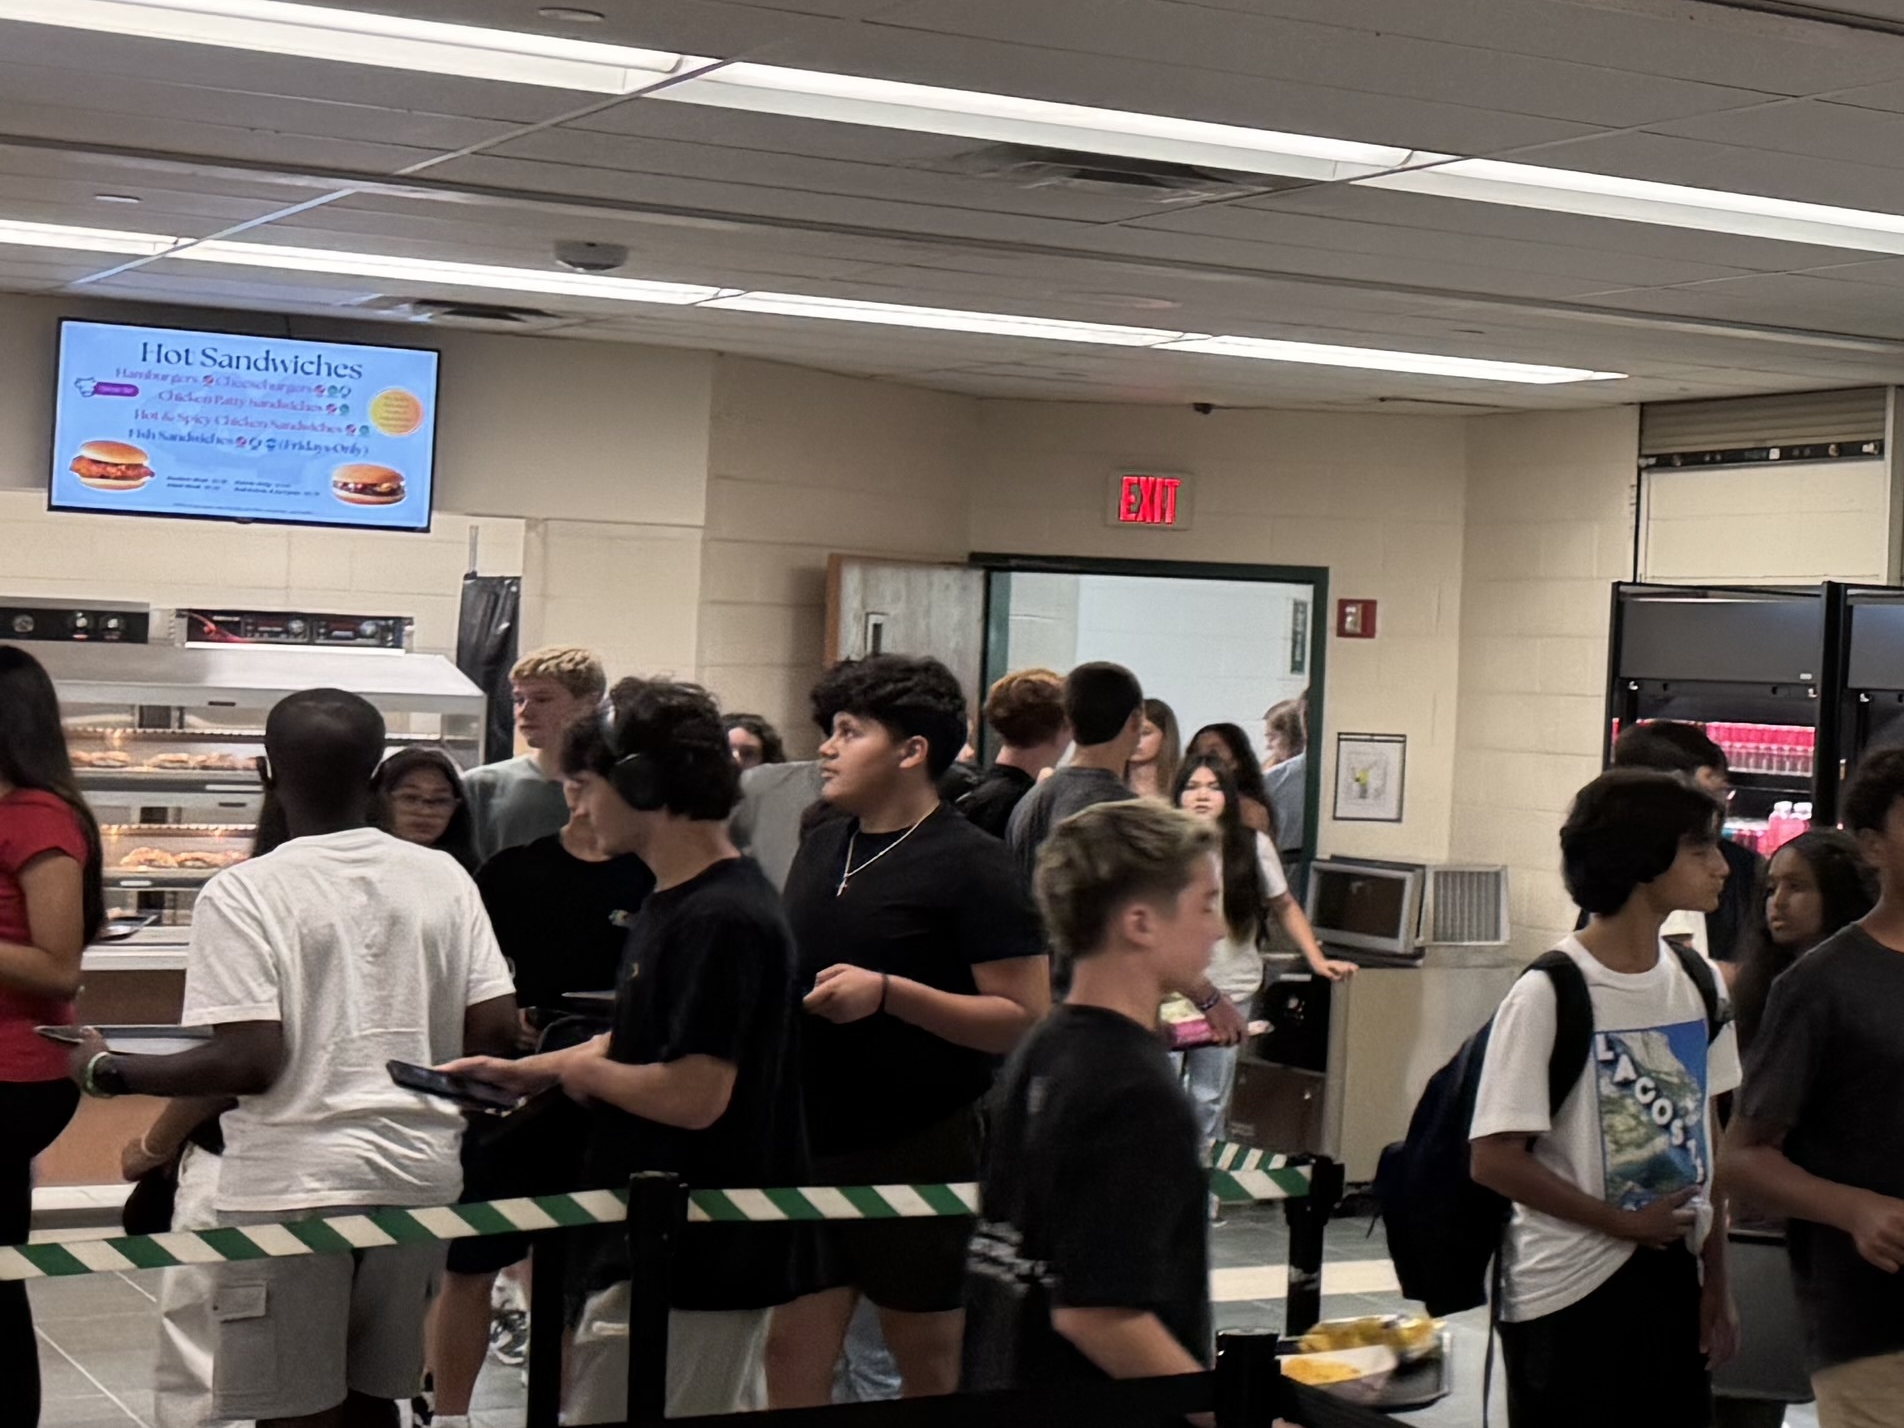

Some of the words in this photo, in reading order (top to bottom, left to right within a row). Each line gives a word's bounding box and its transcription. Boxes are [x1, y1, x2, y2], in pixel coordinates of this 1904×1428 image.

[116, 368, 200, 384] Hamburgers
[141, 341, 194, 366] Hot
[200, 347, 364, 380] Sandwiches
[1120, 476, 1181, 523] EXIT
